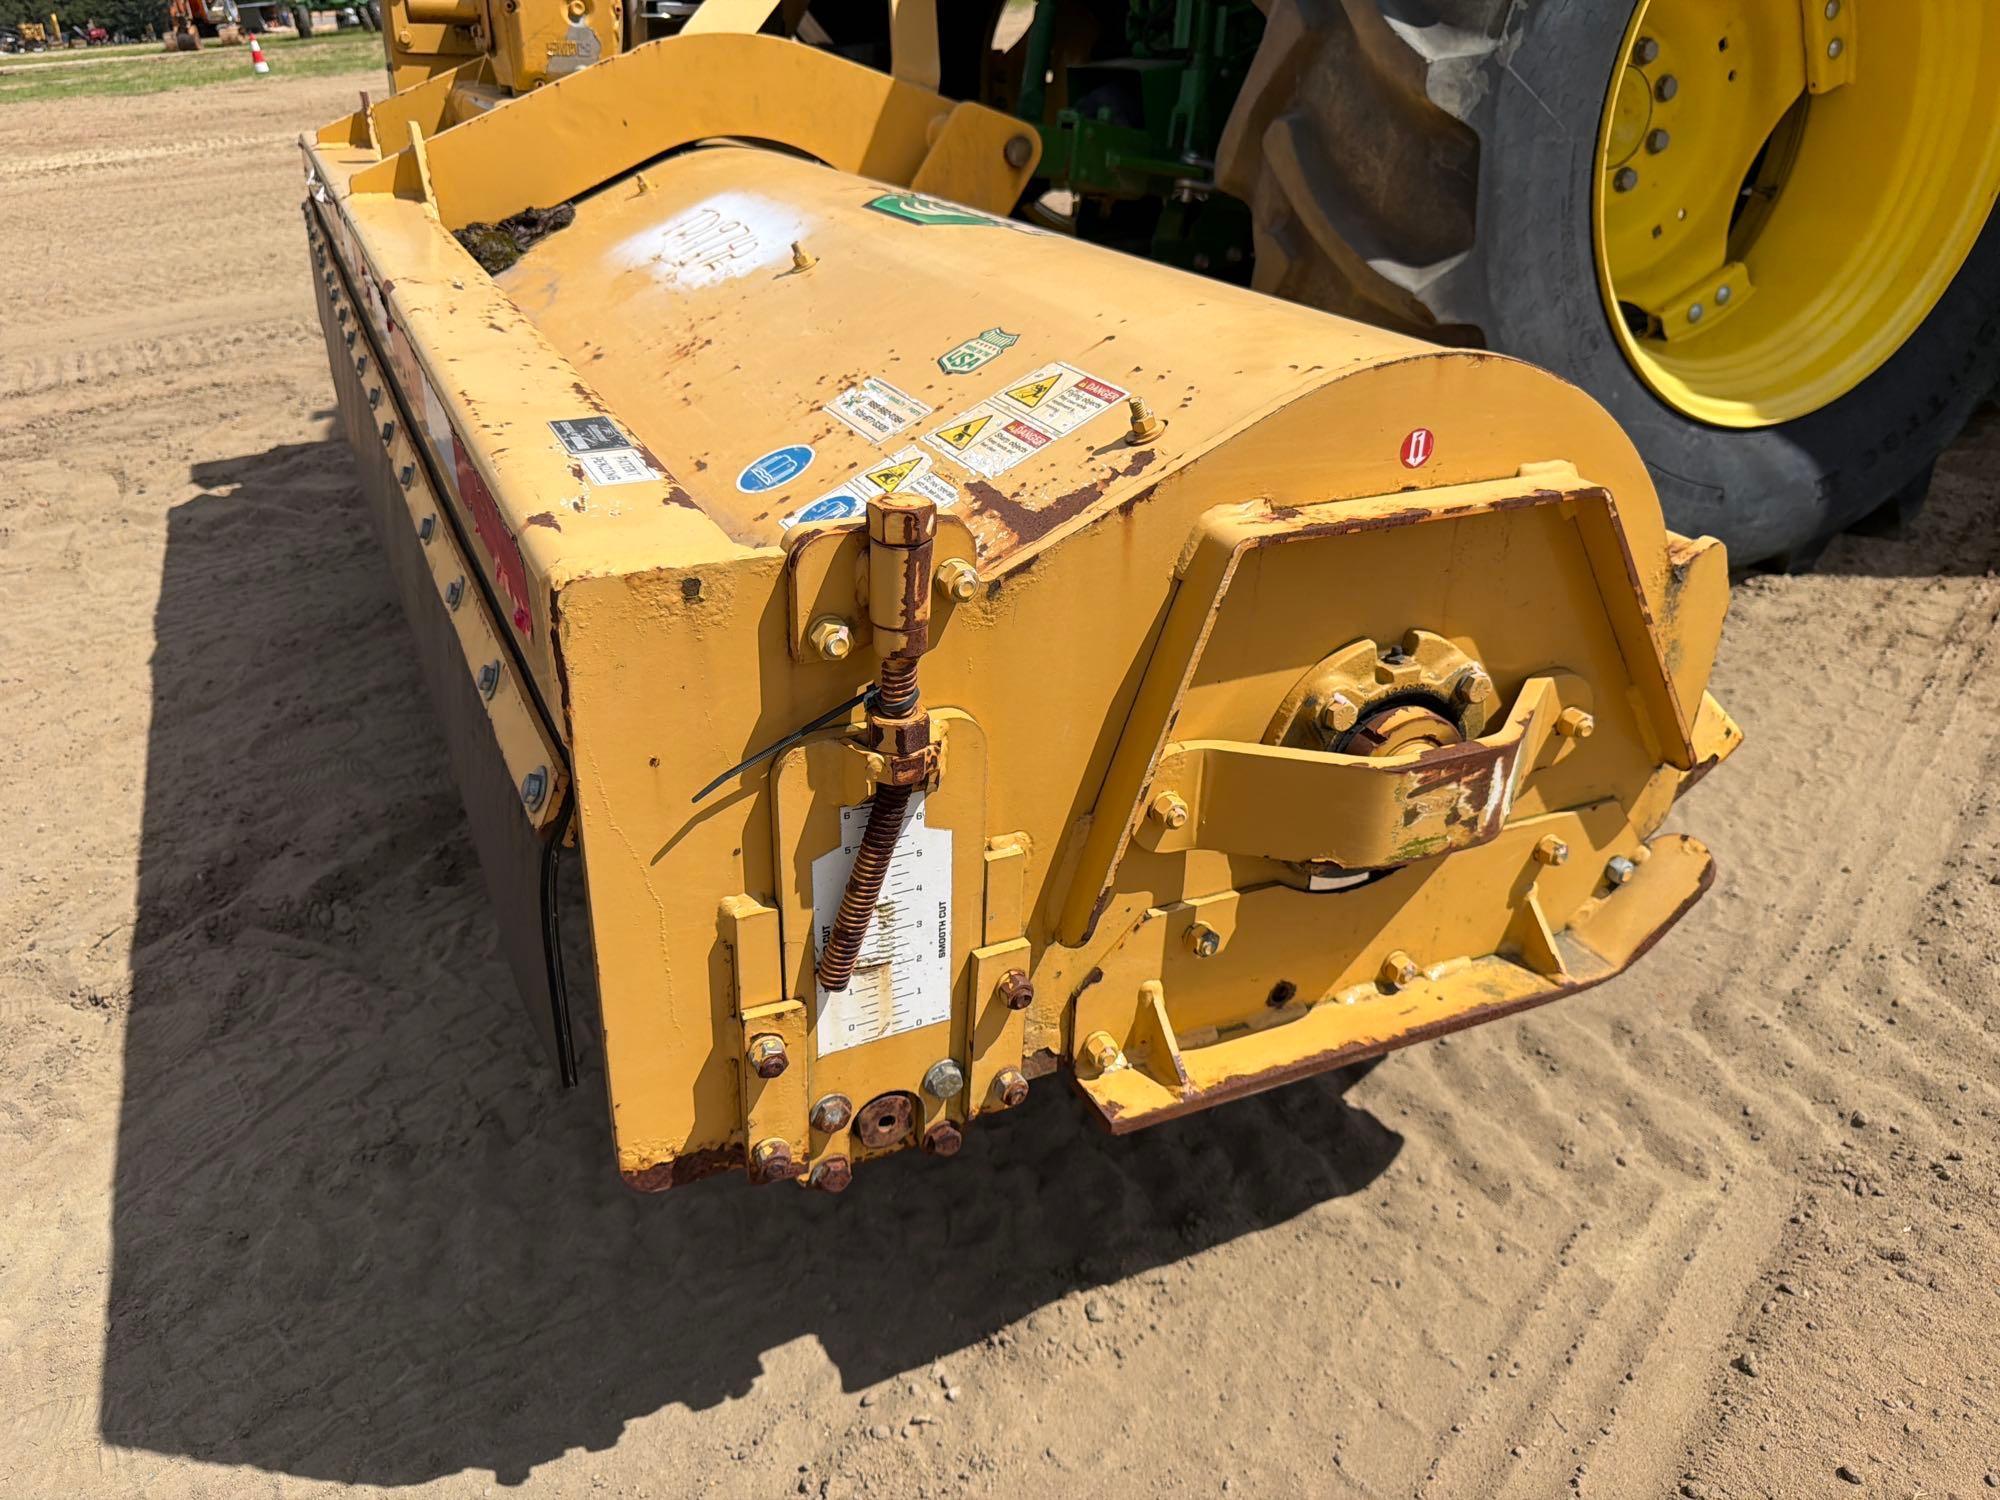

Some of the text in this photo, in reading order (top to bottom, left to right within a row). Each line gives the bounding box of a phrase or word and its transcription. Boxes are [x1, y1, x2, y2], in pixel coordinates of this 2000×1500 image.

[946, 350, 981, 368] USA
[1086, 383, 1120, 402] DANGER
[1081, 395, 1103, 409] objects
[1016, 426, 1047, 446] DANGER
[1008, 440, 1029, 453] objects
[592, 455, 622, 481] PENDING
[614, 455, 642, 477] PATENT
[844, 812, 850, 820] 6
[916, 812, 923, 820] 6
[916, 920, 923, 928] 3
[938, 901, 947, 959] SMOOTH CUT
[822, 925, 831, 945] CUT
